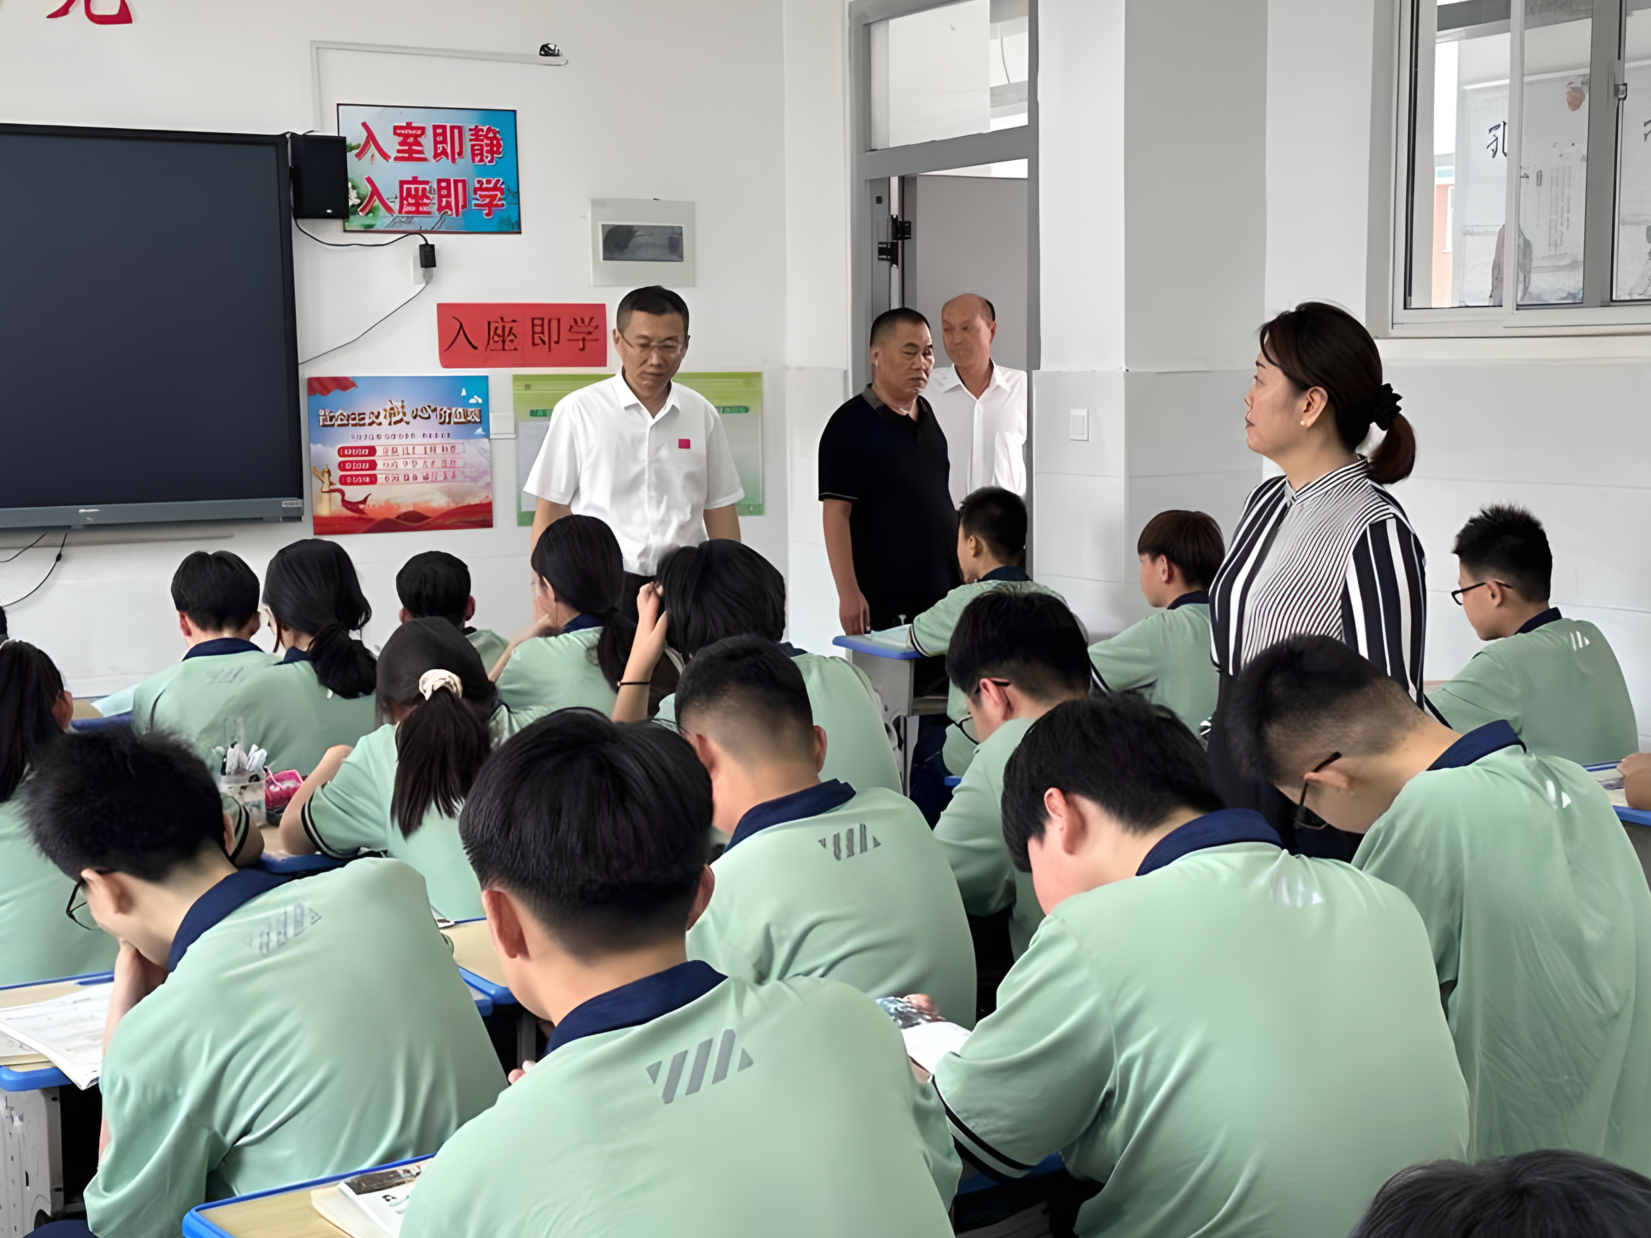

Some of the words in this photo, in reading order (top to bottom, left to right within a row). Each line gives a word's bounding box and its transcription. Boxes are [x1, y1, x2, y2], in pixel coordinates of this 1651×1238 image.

[354, 121, 504, 165] 入室即静
[357, 176, 506, 218] 入座即学
[444, 316, 600, 353] 入座即学
